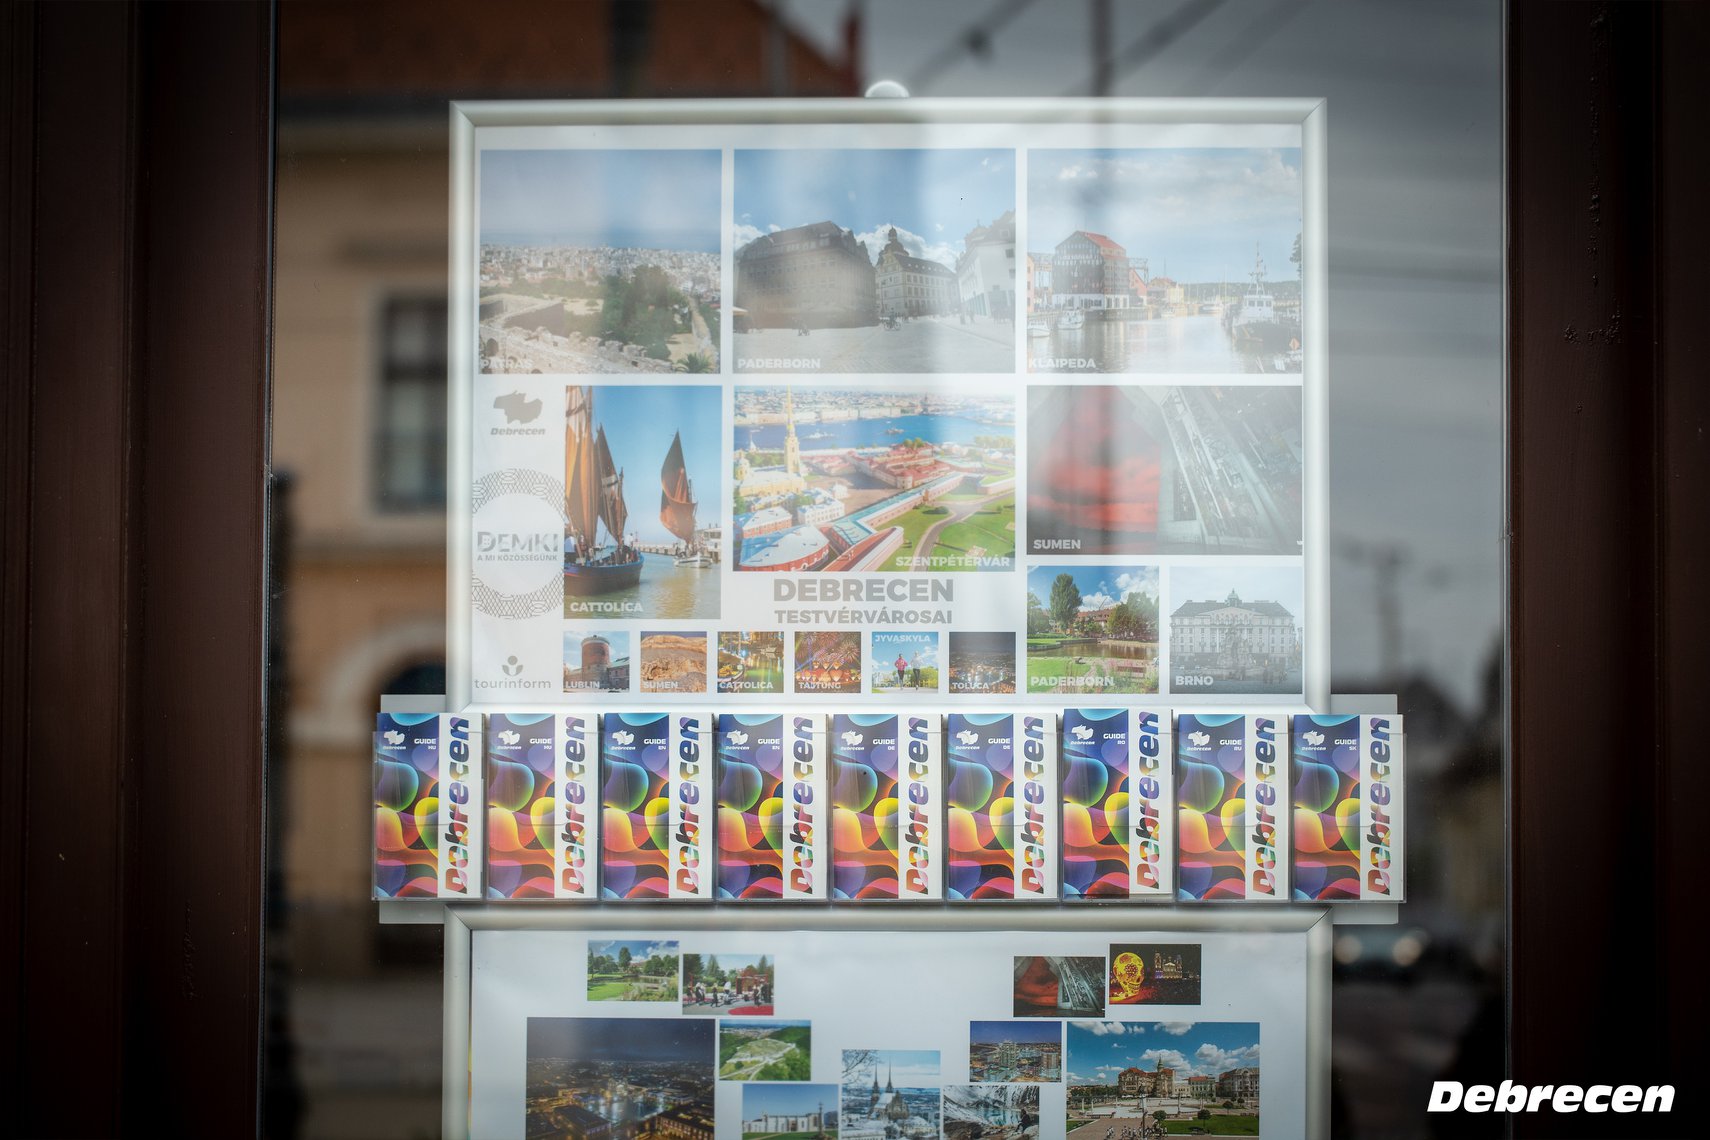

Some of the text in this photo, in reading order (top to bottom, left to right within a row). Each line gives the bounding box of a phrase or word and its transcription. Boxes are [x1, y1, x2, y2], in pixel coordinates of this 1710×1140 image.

[737, 358, 821, 369] PADERBORN
[1028, 358, 1097, 369] KLAIPEDA
[490, 427, 546, 436] Debrecen
[477, 531, 559, 552] DEMKI
[1033, 539, 1081, 550] SUMEN
[895, 554, 1010, 567] SZENTPÉTERVÁR
[773, 578, 954, 602] DEBRECEN
[570, 601, 643, 612] CATTOLICA
[774, 606, 953, 624] TESTVÉRVÁROSAI
[875, 634, 931, 643] JYVASKYLA
[474, 678, 551, 689] tourinform
[565, 681, 600, 689] LUBLIN
[642, 681, 679, 689] SUMEN
[719, 681, 773, 689] CATTOLICA
[952, 682, 989, 690] TOLUCA
[1030, 676, 1114, 687] PADERBORN
[1175, 675, 1214, 686] BRNO
[445, 716, 469, 894] Debrecen
[561, 716, 586, 894] Debrecen
[675, 716, 700, 894] Debrecen
[789, 716, 814, 894] Debrecen
[904, 716, 929, 894] Debrecen
[1020, 716, 1045, 894] Debrecen
[1135, 711, 1160, 889] Debrecen
[1252, 717, 1276, 896] Debrecen
[1367, 717, 1391, 896] Debrecen
